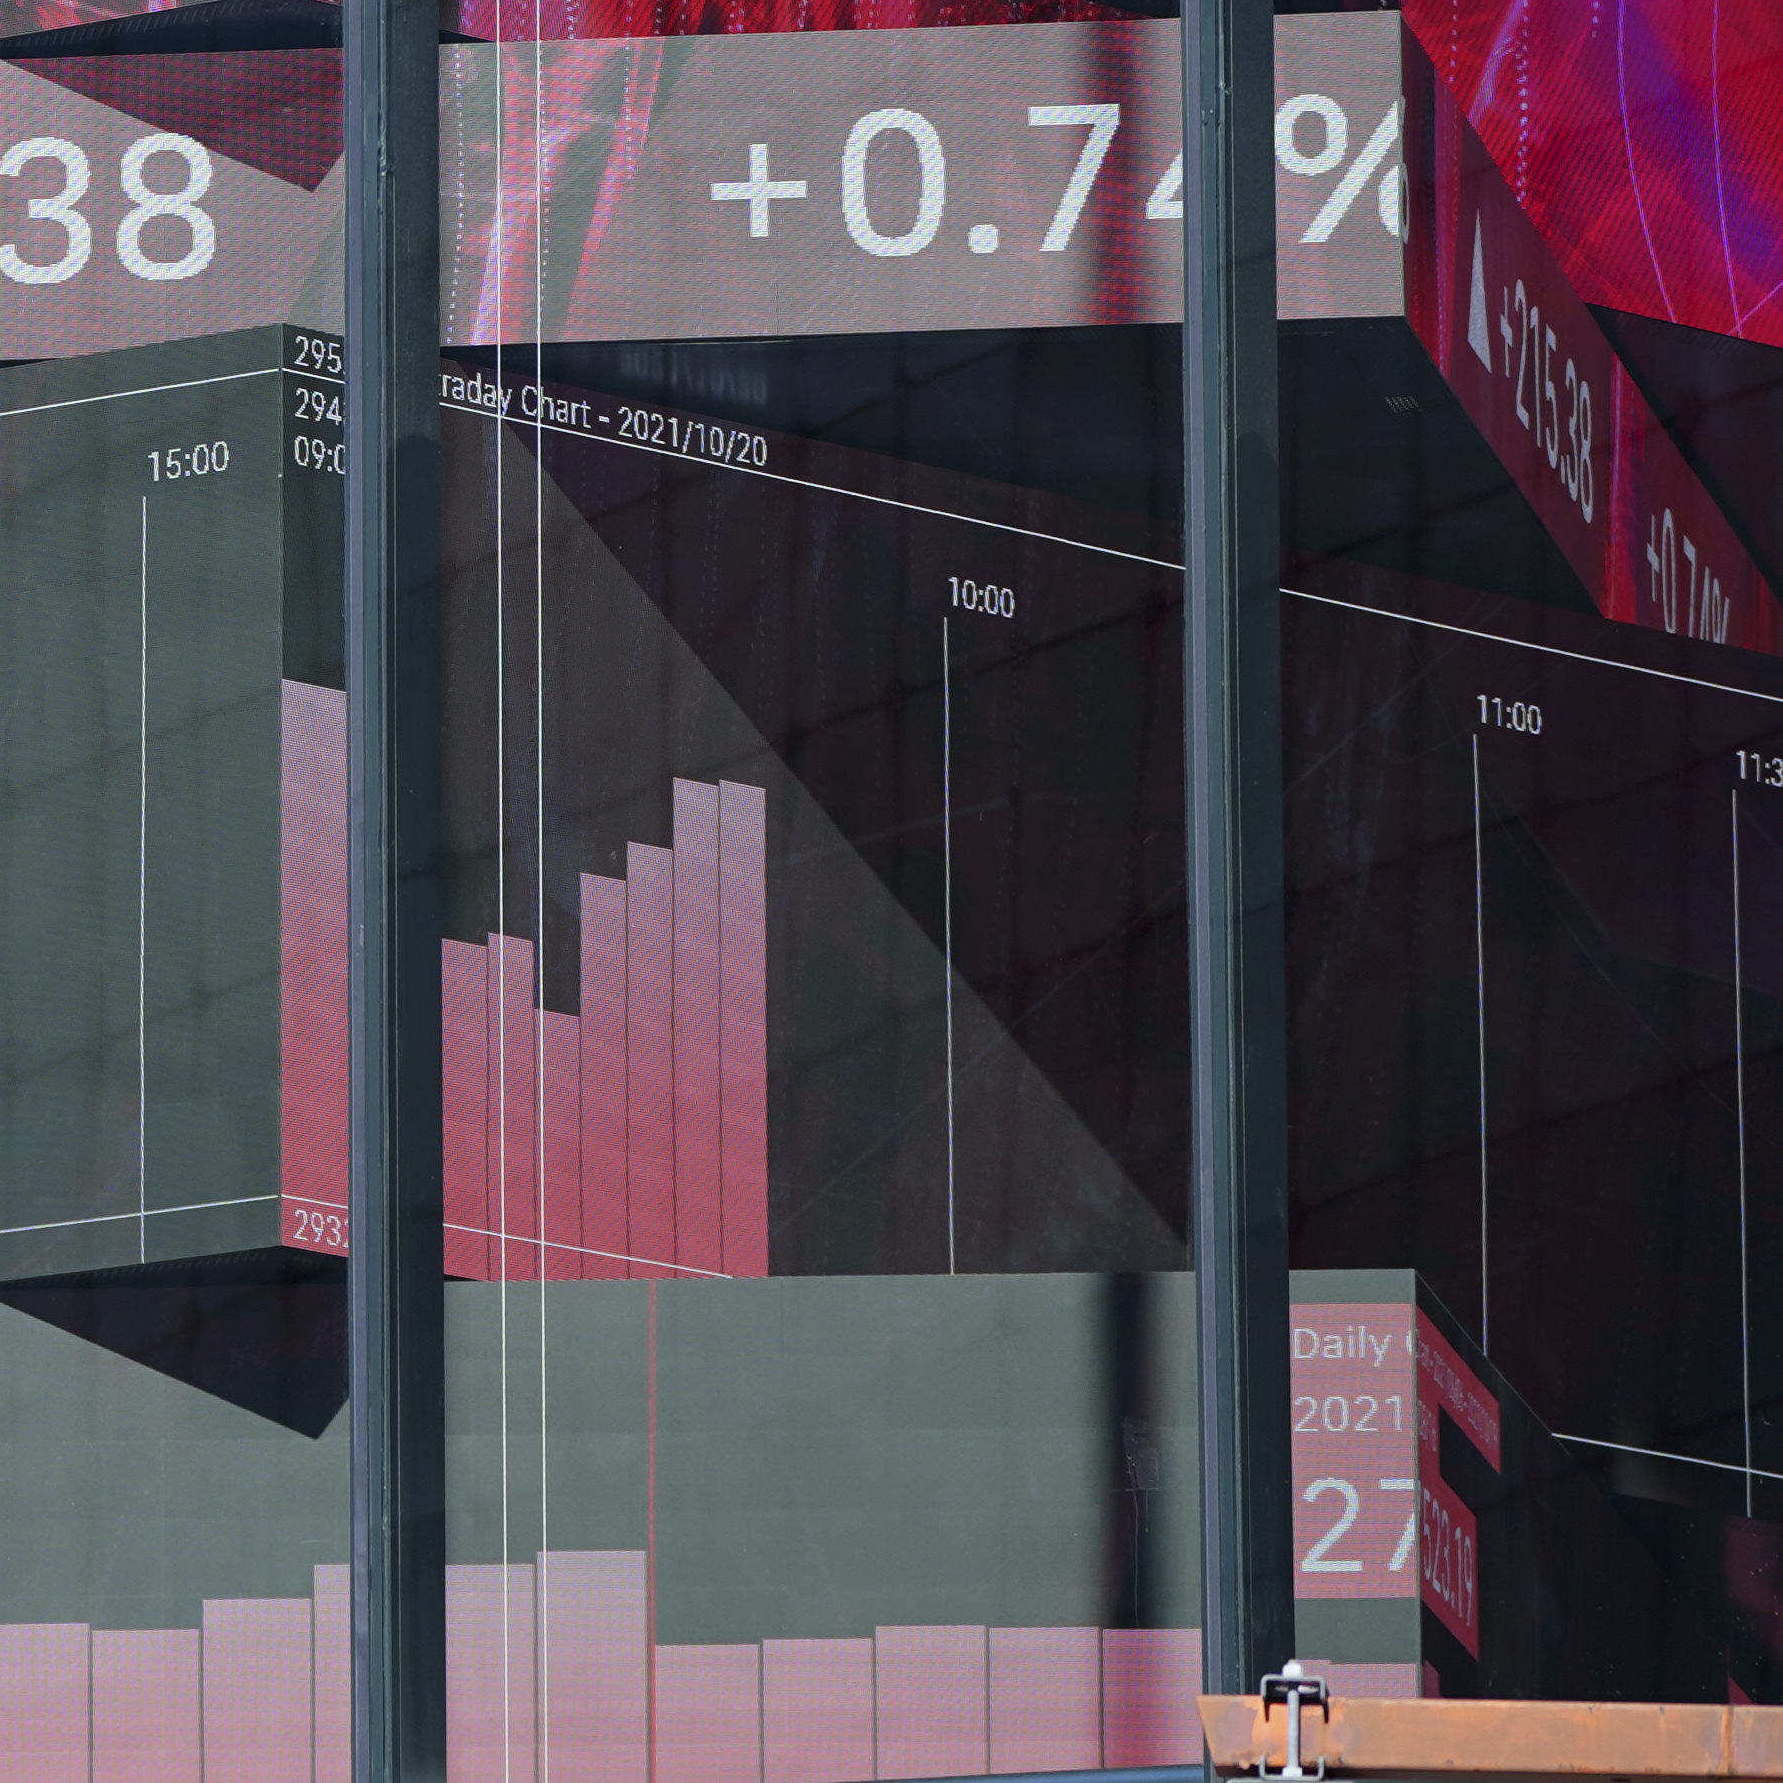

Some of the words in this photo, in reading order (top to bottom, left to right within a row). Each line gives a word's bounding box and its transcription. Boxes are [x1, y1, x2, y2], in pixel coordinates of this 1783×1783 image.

[293, 335, 346, 375] 295
[293, 387, 346, 426] 294
[438, 372, 512, 417] raday
[521, 384, 592, 429] Chart
[618, 405, 768, 467] 2021/10/20
[1500, 279, 1594, 524] +215.38
[147, 440, 230, 481] 15:00
[293, 435, 346, 475] 09:0
[948, 576, 1015, 618] 10:00
[1476, 694, 1543, 735] 11:00
[1736, 750, 1783, 788] 11:3
[1293, 1325, 1393, 1368] Daily
